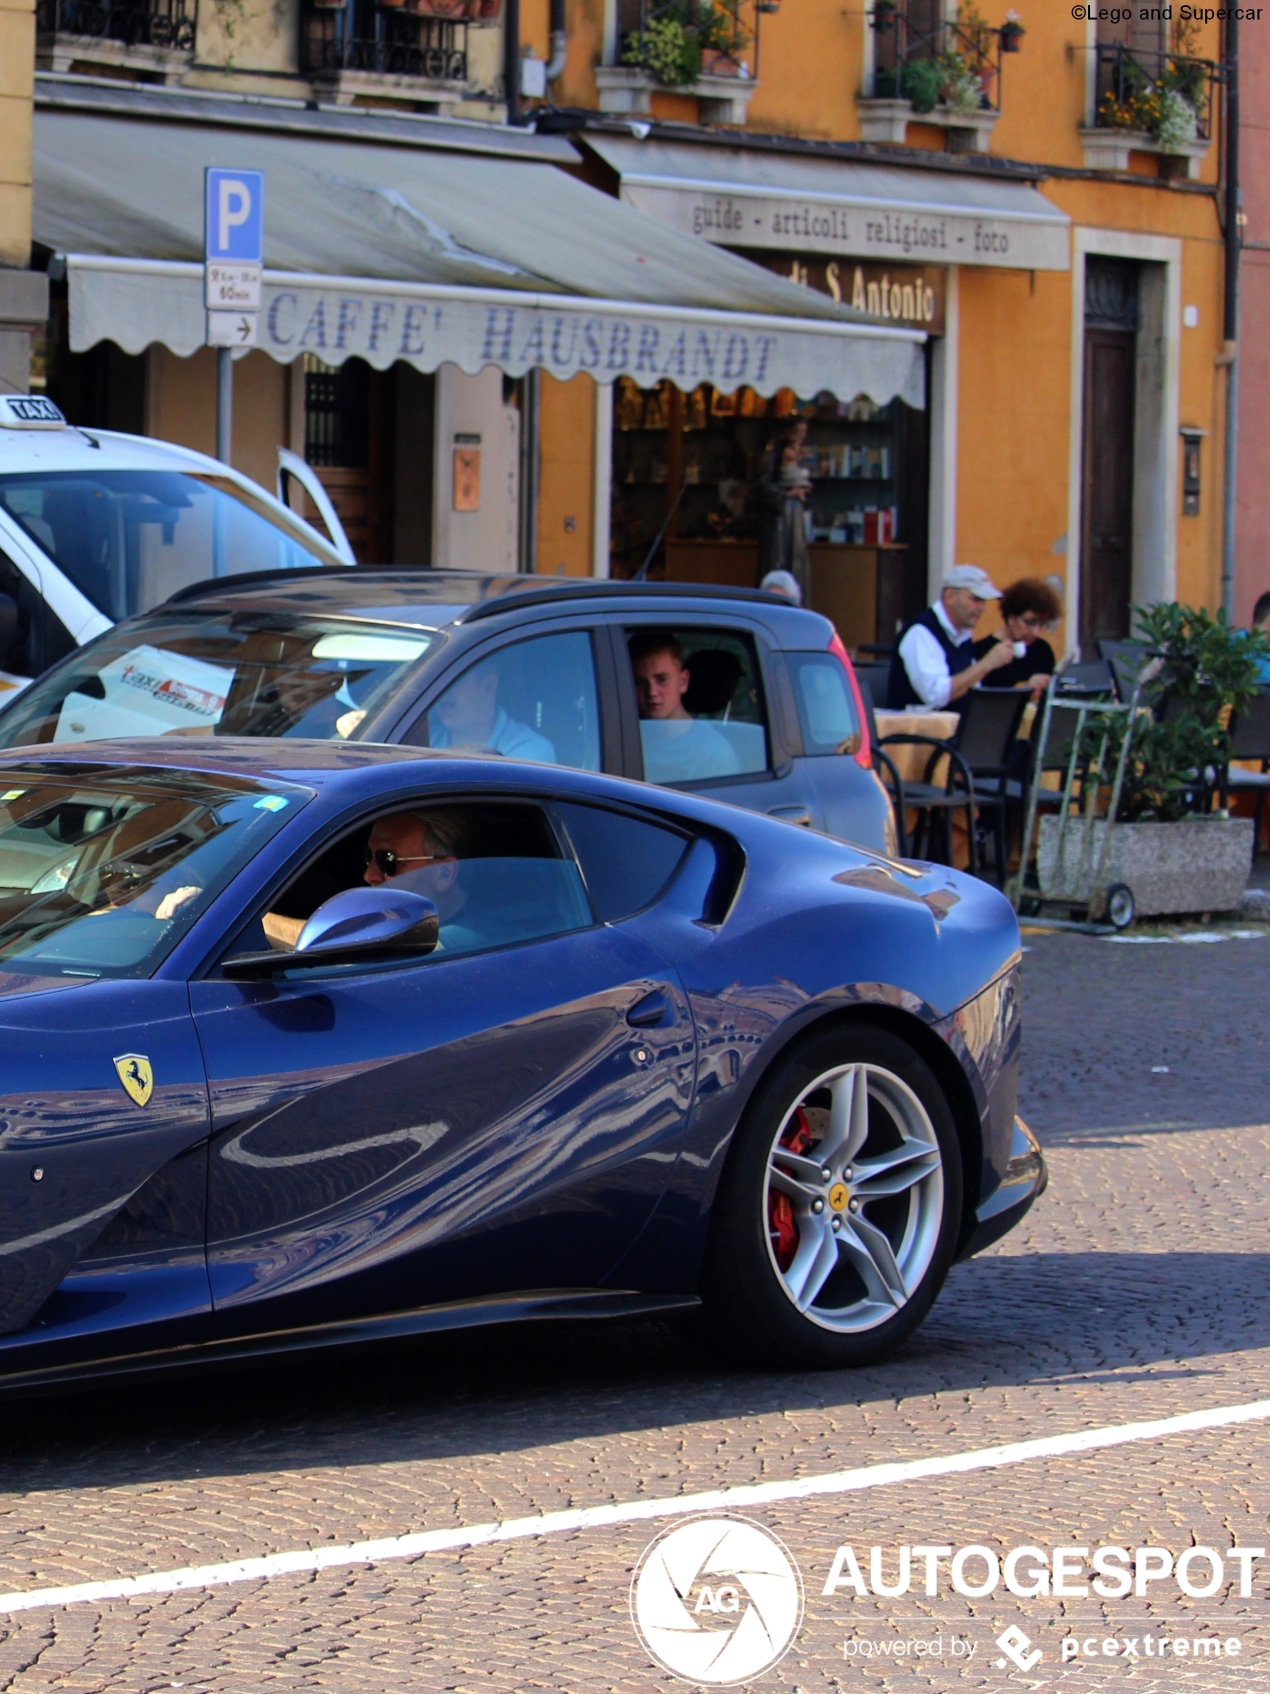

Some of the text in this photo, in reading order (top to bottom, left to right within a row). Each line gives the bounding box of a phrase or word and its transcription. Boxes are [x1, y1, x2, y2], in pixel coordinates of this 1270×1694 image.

[218, 179, 251, 250] P
[693, 200, 743, 235] guide
[773, 208, 849, 240] articoli
[866, 214, 947, 253] religiosi
[975, 223, 1009, 253] foto
[852, 265, 935, 322] Antonio
[267, 292, 778, 383] CAFFE' HAUSBRANDT
[7, 400, 60, 419] TAXI
